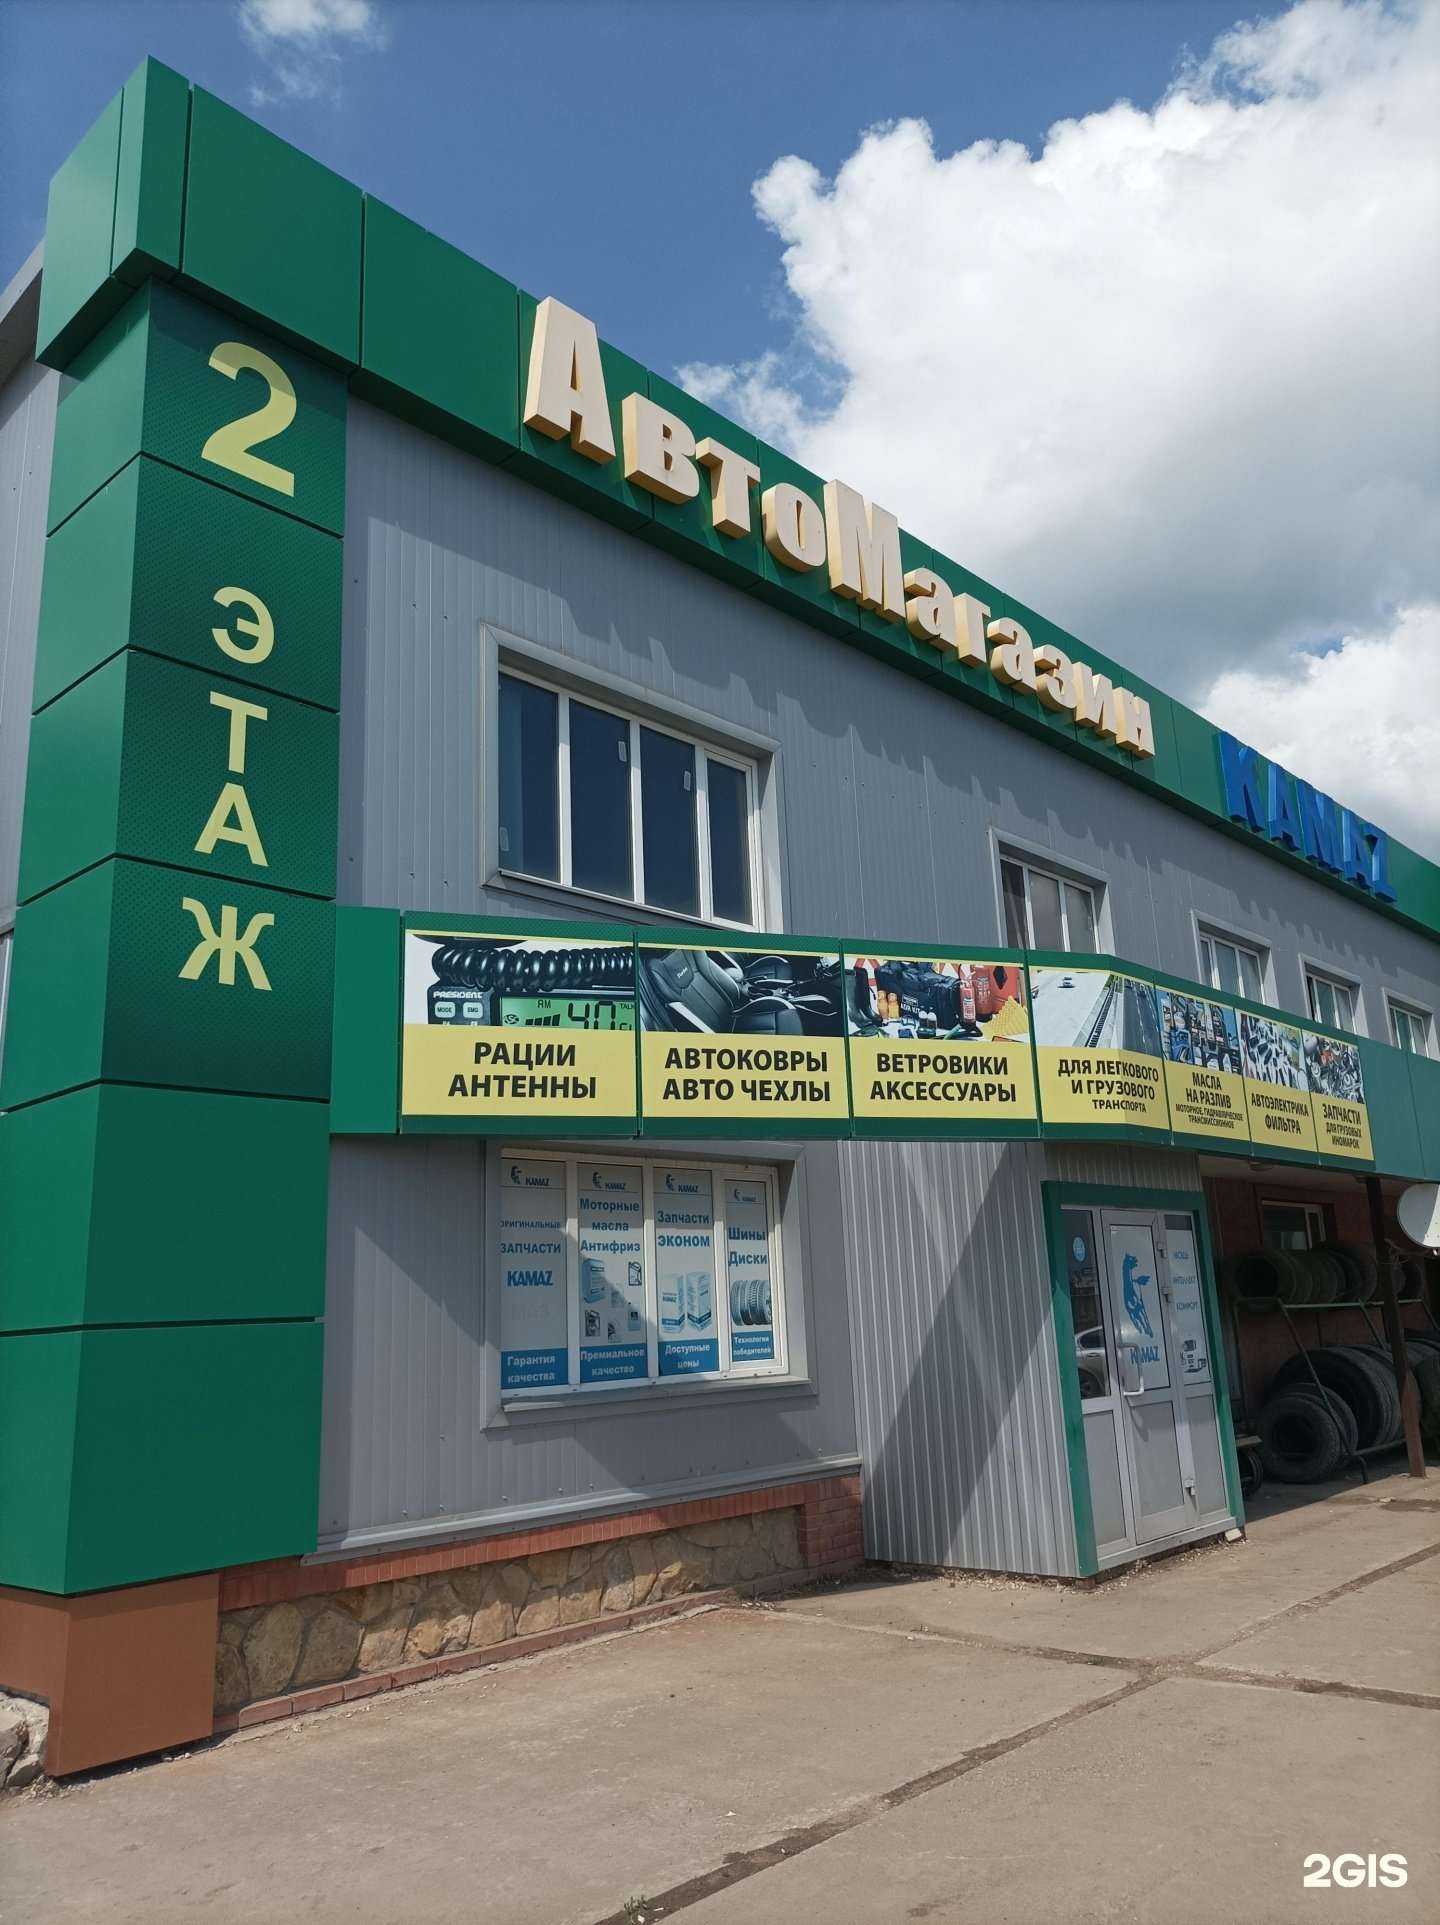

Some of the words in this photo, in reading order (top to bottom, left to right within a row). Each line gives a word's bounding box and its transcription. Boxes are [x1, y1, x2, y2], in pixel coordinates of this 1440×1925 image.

[201, 341, 297, 497] 2
[178, 586, 275, 991] ЭТАЖ
[1218, 730, 1398, 904] KAMAZ
[433, 991, 483, 999] PRESIDENT
[474, 1041, 576, 1071] РАЦИИ
[665, 1047, 828, 1072] АВТОКОВРЫ
[877, 1053, 1008, 1076] ВЕТРОВИКИ
[1058, 1059, 1092, 1077] ДЛЯ
[1096, 1060, 1159, 1082] ЛЕГКОВОГО
[448, 1074, 596, 1099] АНТЕННЫ
[1192, 1072, 1222, 1091] МАСЛА
[663, 1078, 734, 1100] АВТО
[741, 1079, 830, 1102] ЧЕХЛЫ
[870, 1080, 1016, 1102] АКСЕССУАРЫ
[1071, 1080, 1083, 1094] И
[1087, 1080, 1155, 1100] ГРУЗОВОГО
[1185, 1087, 1199, 1103] НА
[1200, 1090, 1232, 1109] РАЗЛИВ
[1092, 1099, 1147, 1113] ТРАНСПОРТА
[1251, 1093, 1309, 1117] АВТОЭЛЕКТРИКА
[1322, 1103, 1362, 1125] ЗАПЧАСТИ
[1264, 1114, 1301, 1135] ФИЛЬТРА
[1326, 1122, 1337, 1134] ДЛЯ
[1337, 1123, 1362, 1138] ГРУЗОВЫХ
[1331, 1135, 1360, 1149] ИНОМАРОК
[580, 1198, 640, 1213] Моторные
[657, 1210, 710, 1224] Запчасти
[592, 1221, 629, 1231] масла
[728, 1226, 766, 1241] Шины
[500, 1242, 561, 1254] ЗАПЧАСТИ
[581, 1240, 641, 1254] Антифриз
[727, 1251, 768, 1267] Диски
[507, 1270, 553, 1286] KAMAZ
[580, 1348, 645, 1362] Премиальное
[664, 1343, 711, 1355] Доступные
[507, 1355, 556, 1367] Гарантия
[677, 1360, 700, 1369] цены
[508, 1372, 555, 1384] качества
[592, 1366, 635, 1377] качество
